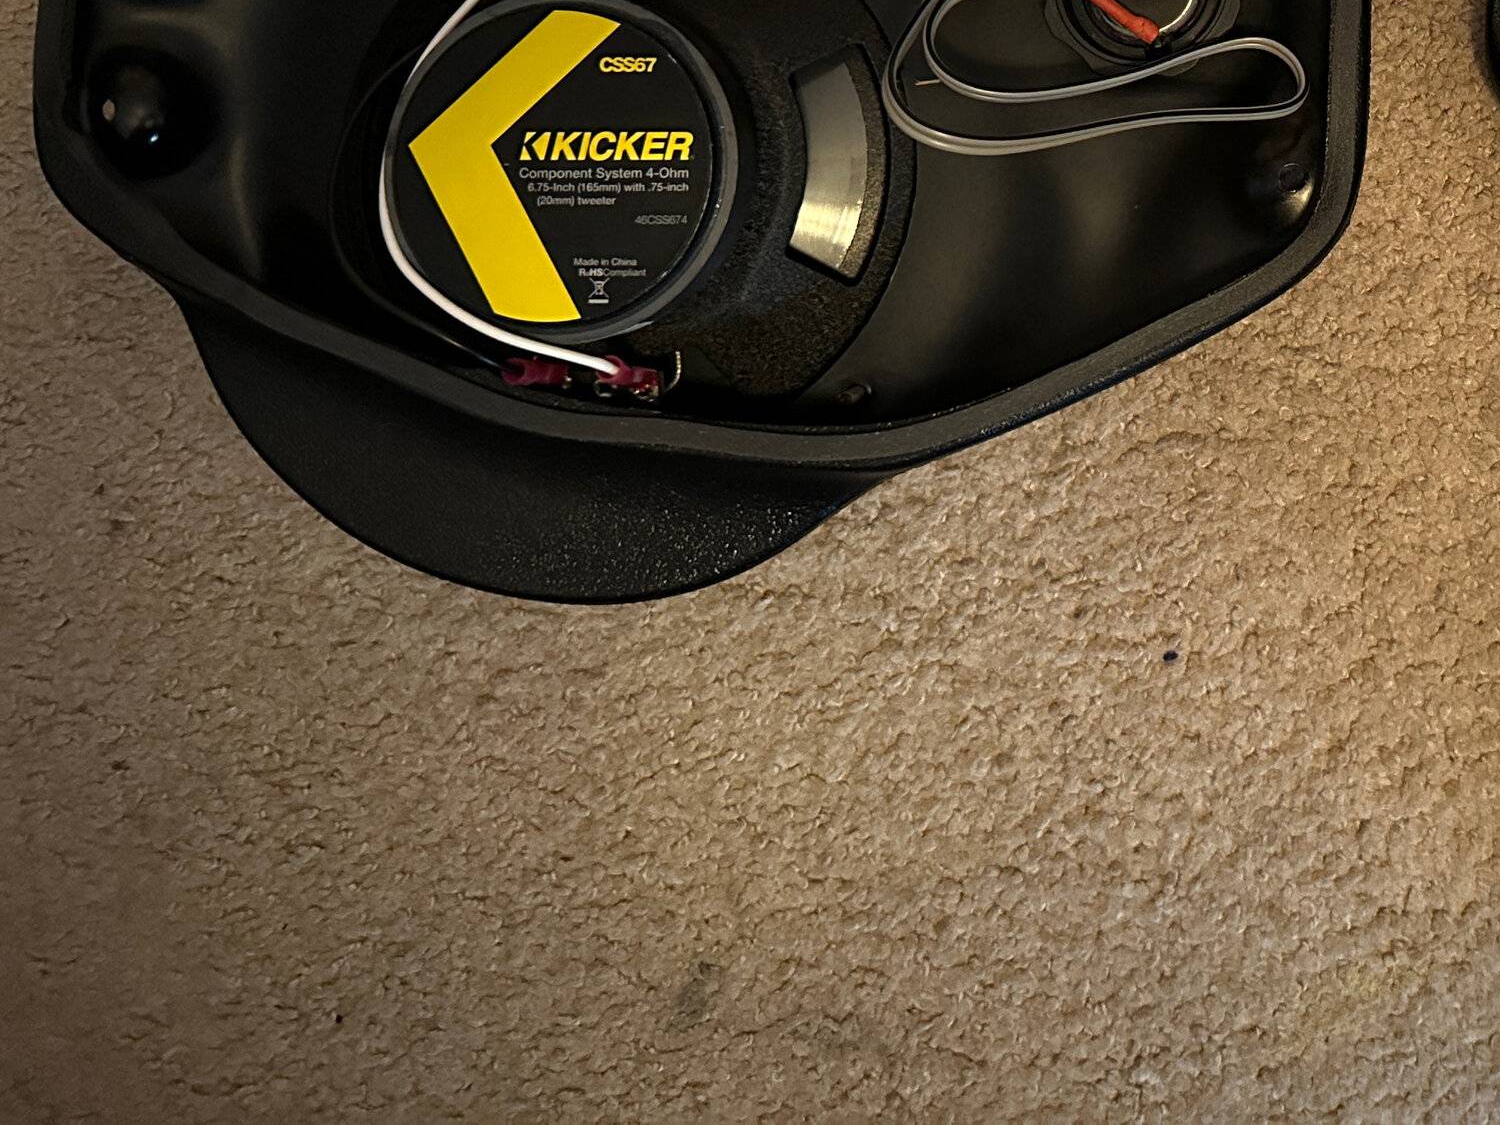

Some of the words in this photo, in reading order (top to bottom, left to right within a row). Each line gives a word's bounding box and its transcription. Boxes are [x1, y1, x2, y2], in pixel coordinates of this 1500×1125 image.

[600, 57, 657, 73] CSS67
[551, 131, 694, 161] KICKER
[519, 167, 593, 181] Component
[596, 167, 643, 181] System
[645, 167, 689, 179] 4-Ohm
[577, 182, 621, 194] (165mm)
[623, 182, 646, 192] with
[537, 195, 575, 207] (20mm)
[577, 196, 617, 205] tweeter
[573, 257, 600, 266] Made
[601, 257, 610, 266] in
[611, 257, 638, 266] China
